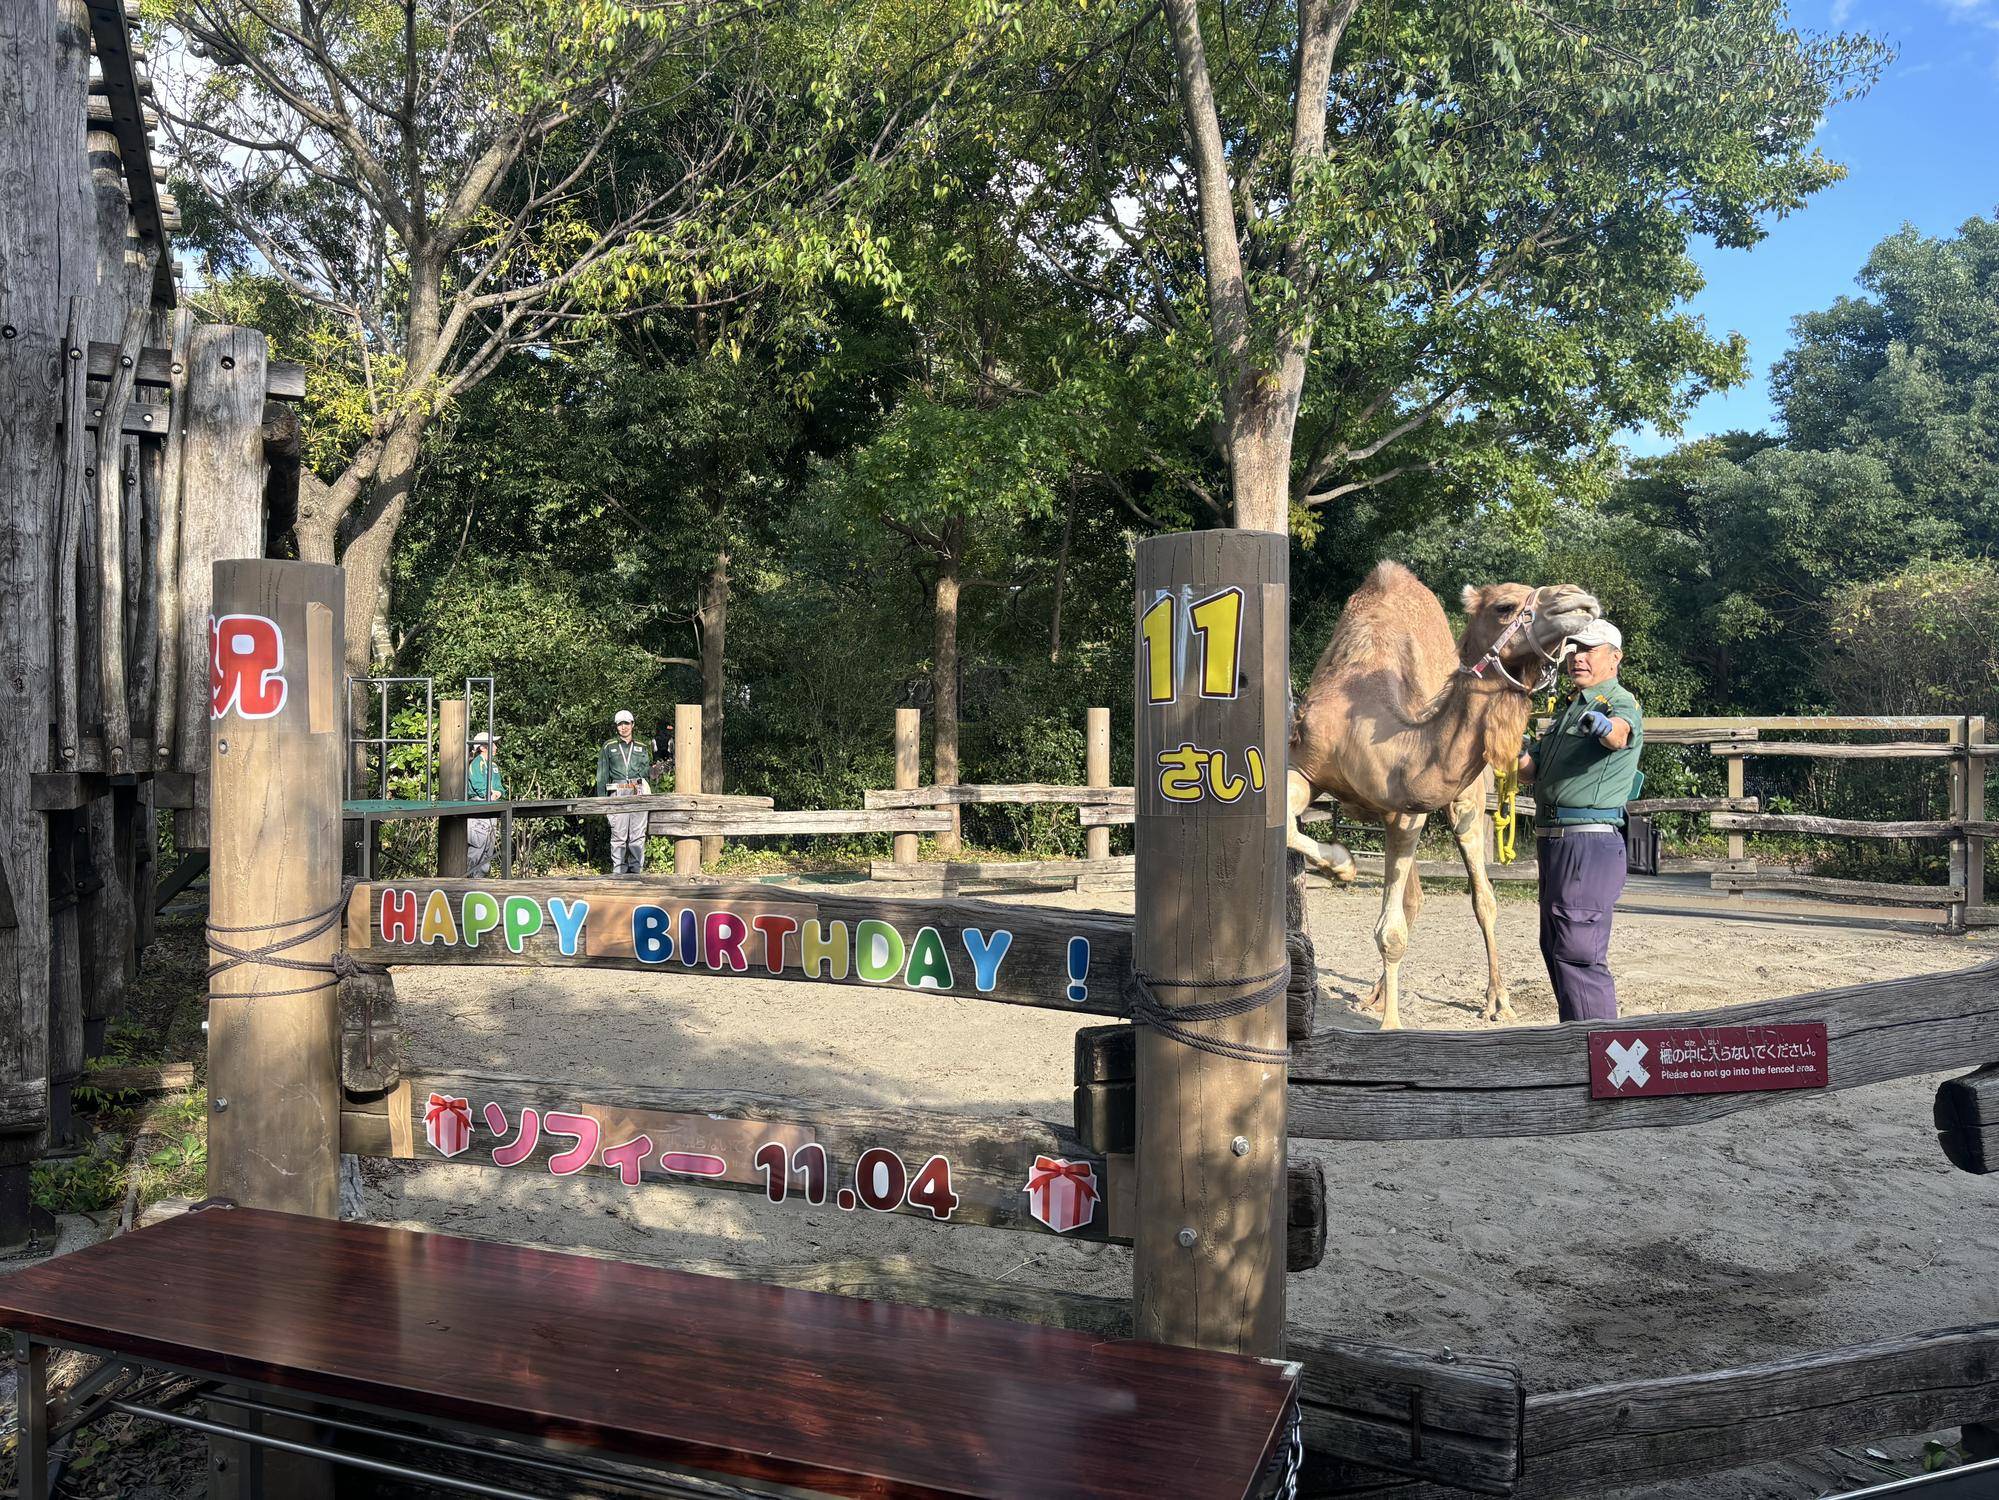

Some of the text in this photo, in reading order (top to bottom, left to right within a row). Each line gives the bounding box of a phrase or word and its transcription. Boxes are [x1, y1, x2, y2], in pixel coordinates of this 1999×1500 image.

[1140, 586, 1245, 705] 11
[1157, 743, 1267, 804] さい
[380, 887, 590, 957] HAPPY
[631, 904, 1013, 991] BIRTHDAY
[1661, 1064, 1816, 1080] Please do not go into the fenced area.
[483, 1101, 960, 1221] ソフィー 11.04
